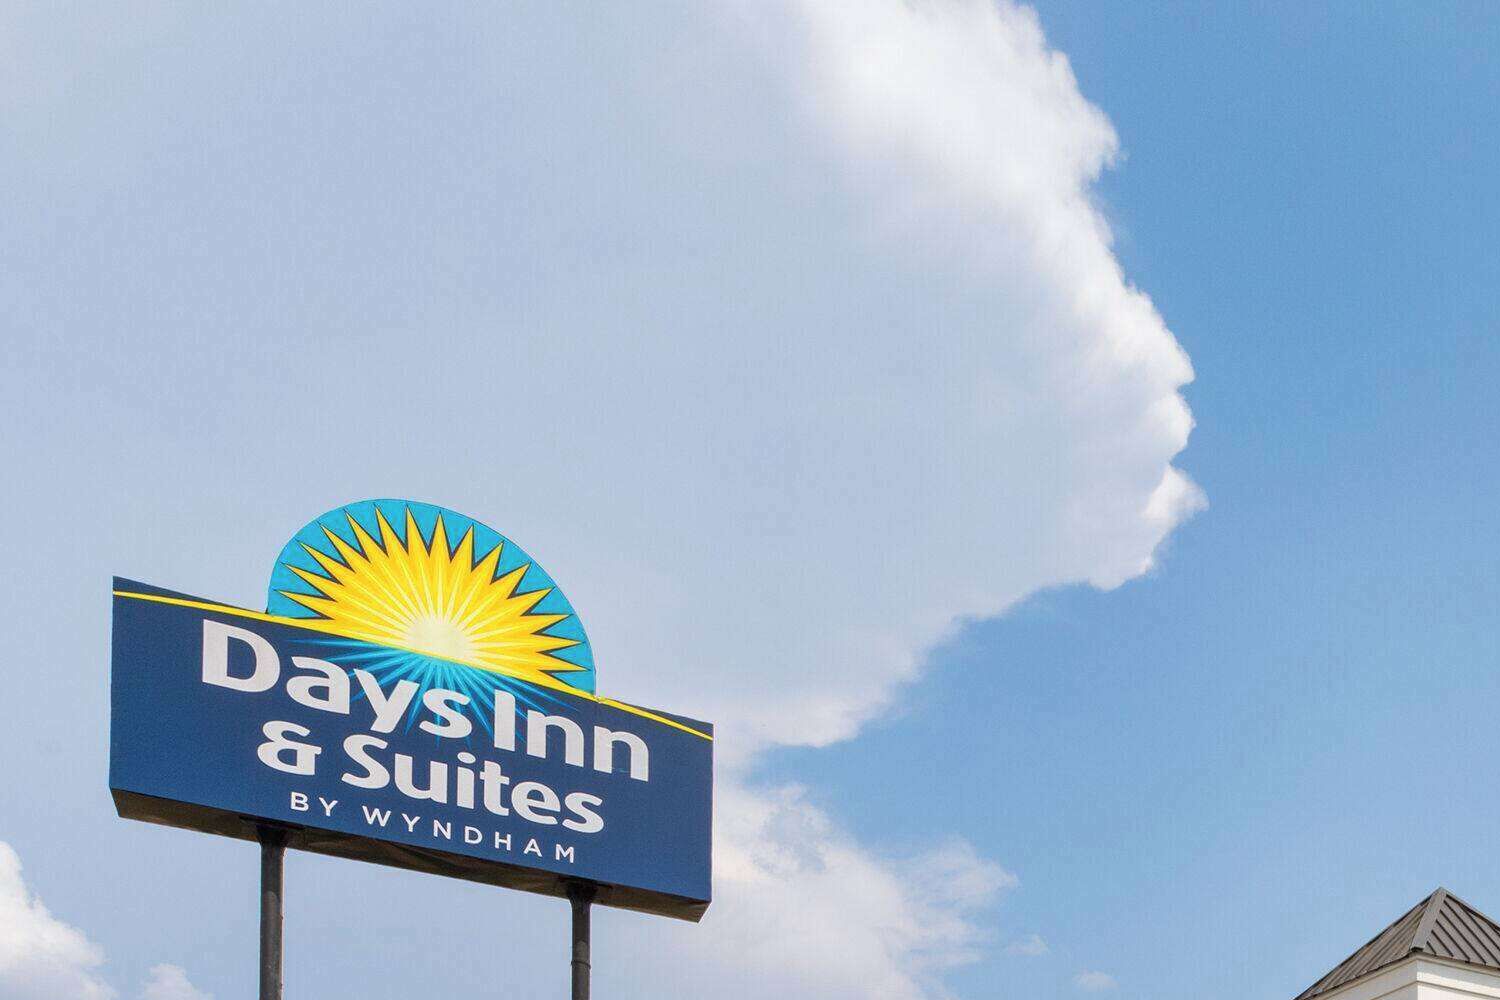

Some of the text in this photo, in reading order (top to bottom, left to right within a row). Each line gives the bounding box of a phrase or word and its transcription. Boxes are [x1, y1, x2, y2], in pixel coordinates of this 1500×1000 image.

[202, 618, 649, 782] Days Inn
[257, 720, 605, 834] & Suites
[290, 791, 575, 864] BY WYNDHAM
